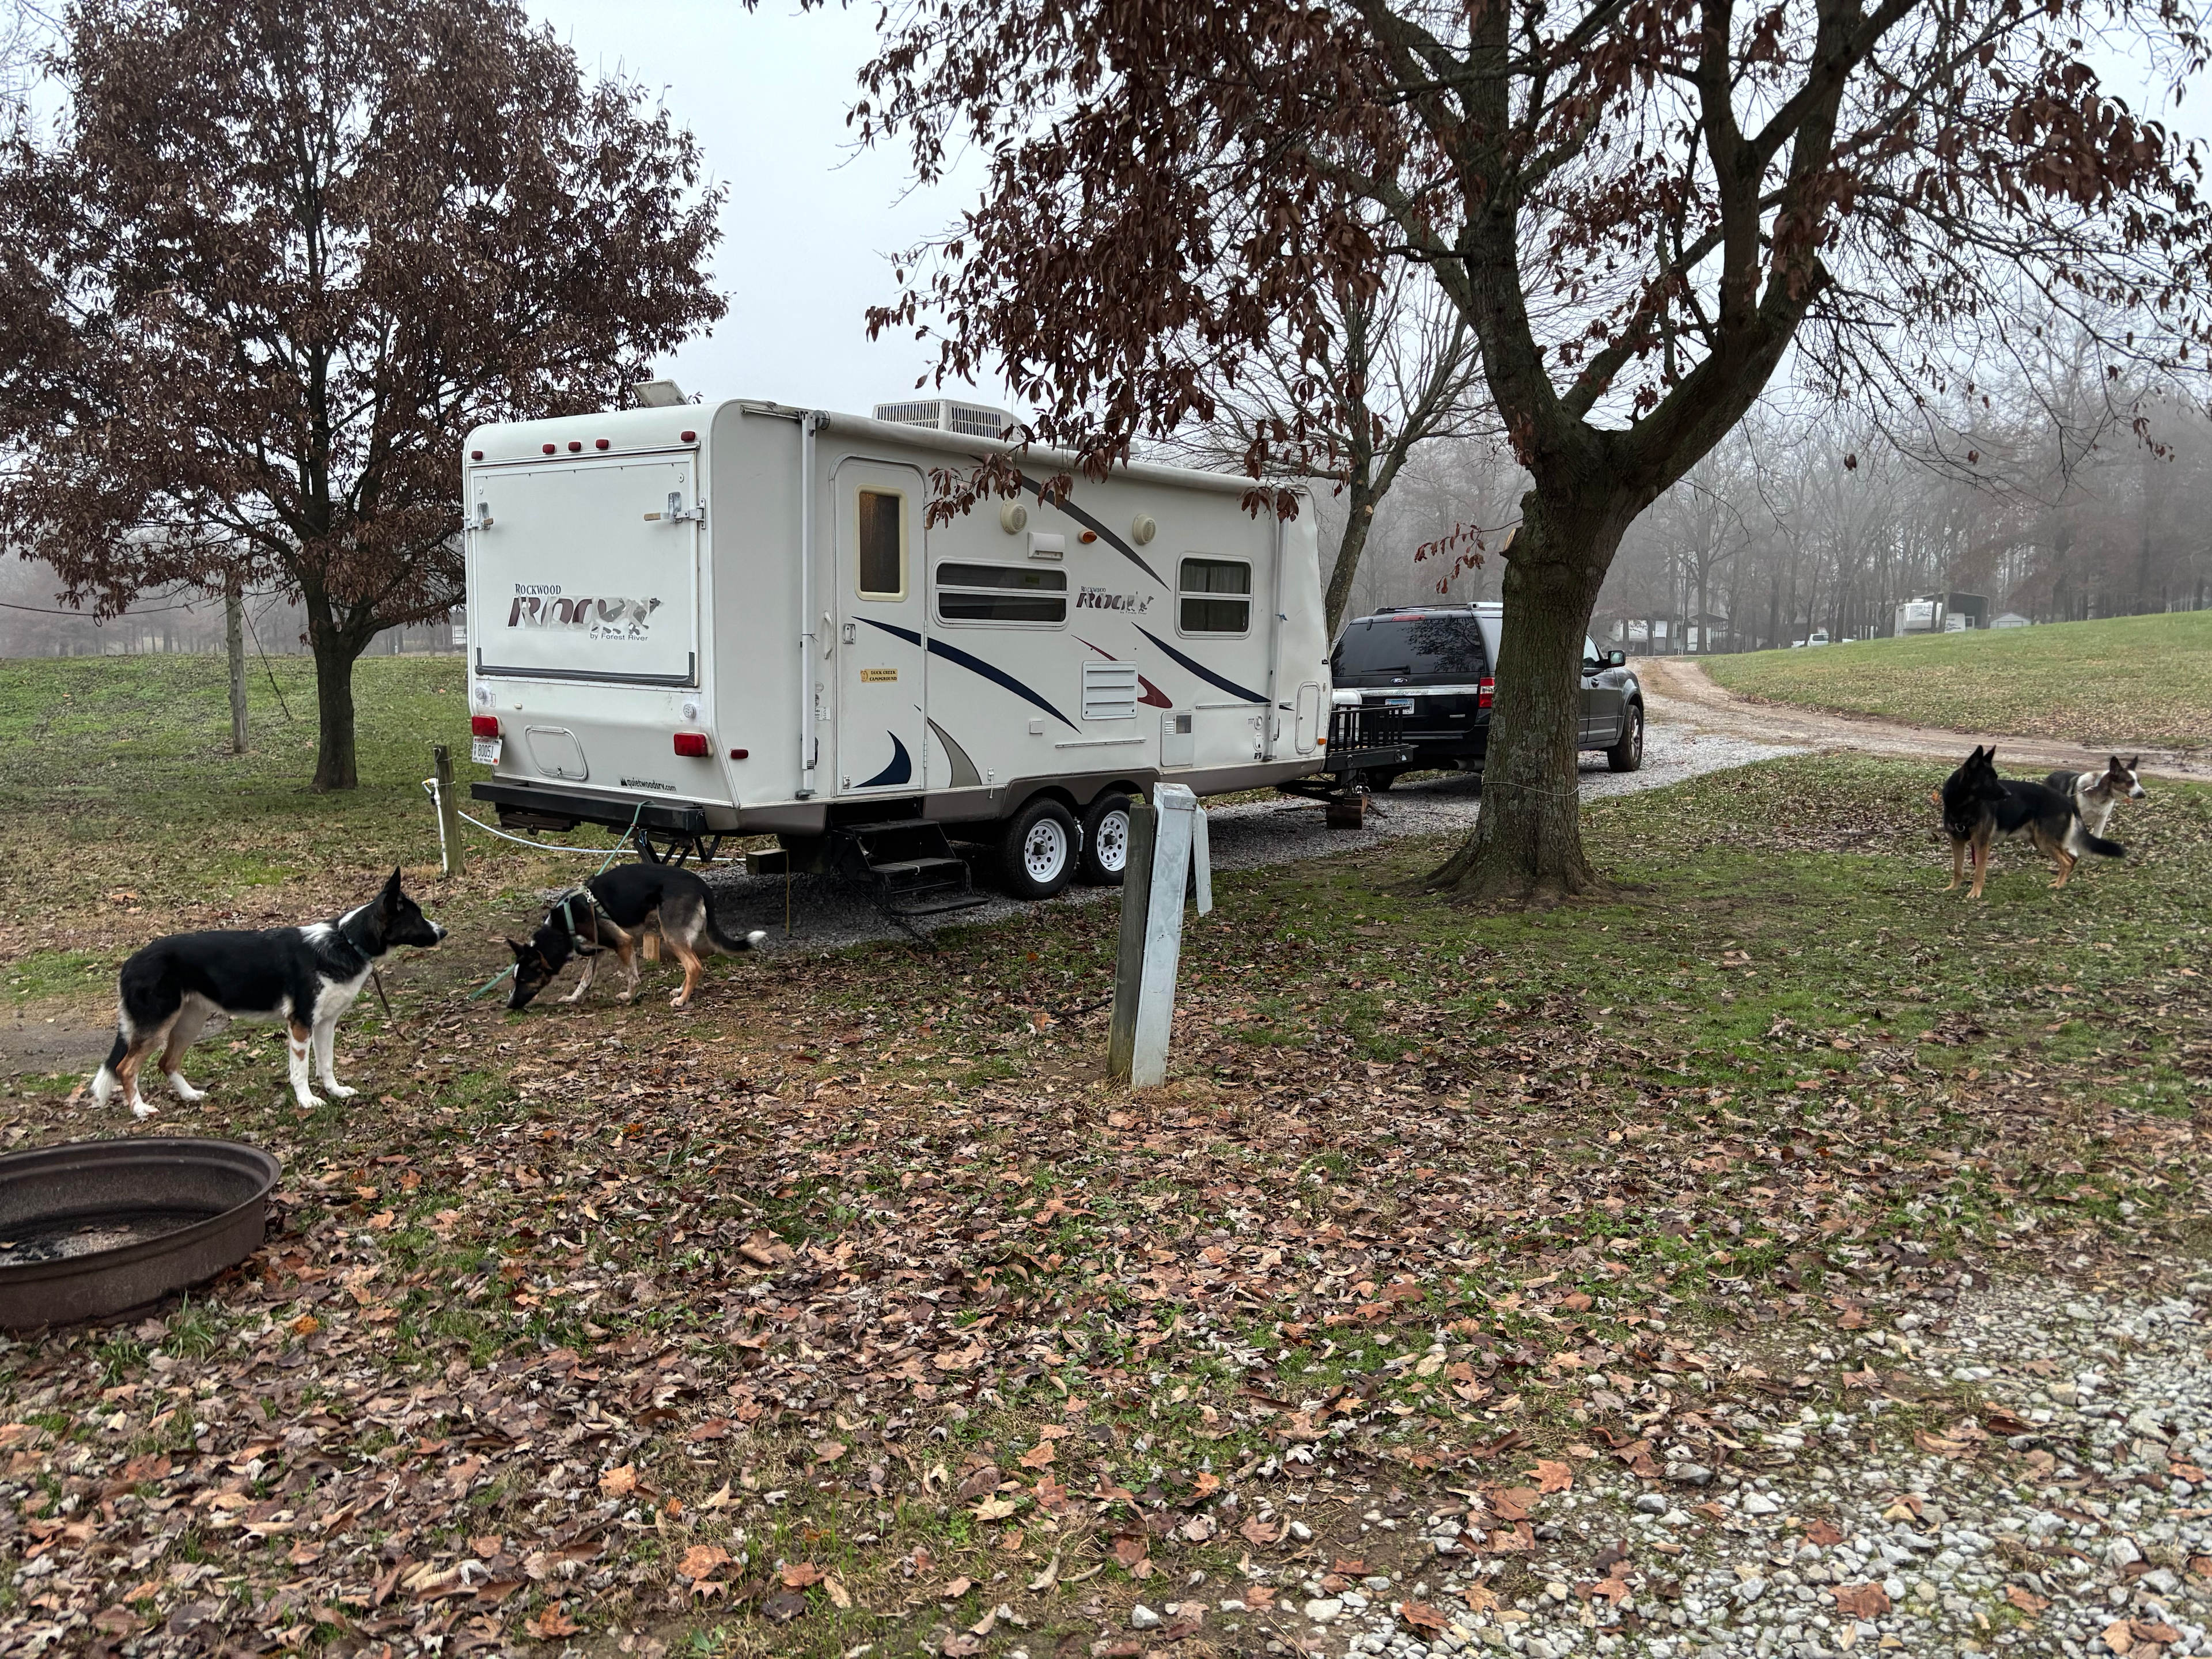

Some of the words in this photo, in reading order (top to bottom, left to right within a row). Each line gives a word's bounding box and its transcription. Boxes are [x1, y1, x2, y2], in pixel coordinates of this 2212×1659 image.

[514, 584, 562, 596] ROCKWOOD
[478, 744, 494, 759] 80051
[627, 778, 677, 791] quietwoodsrv.com
